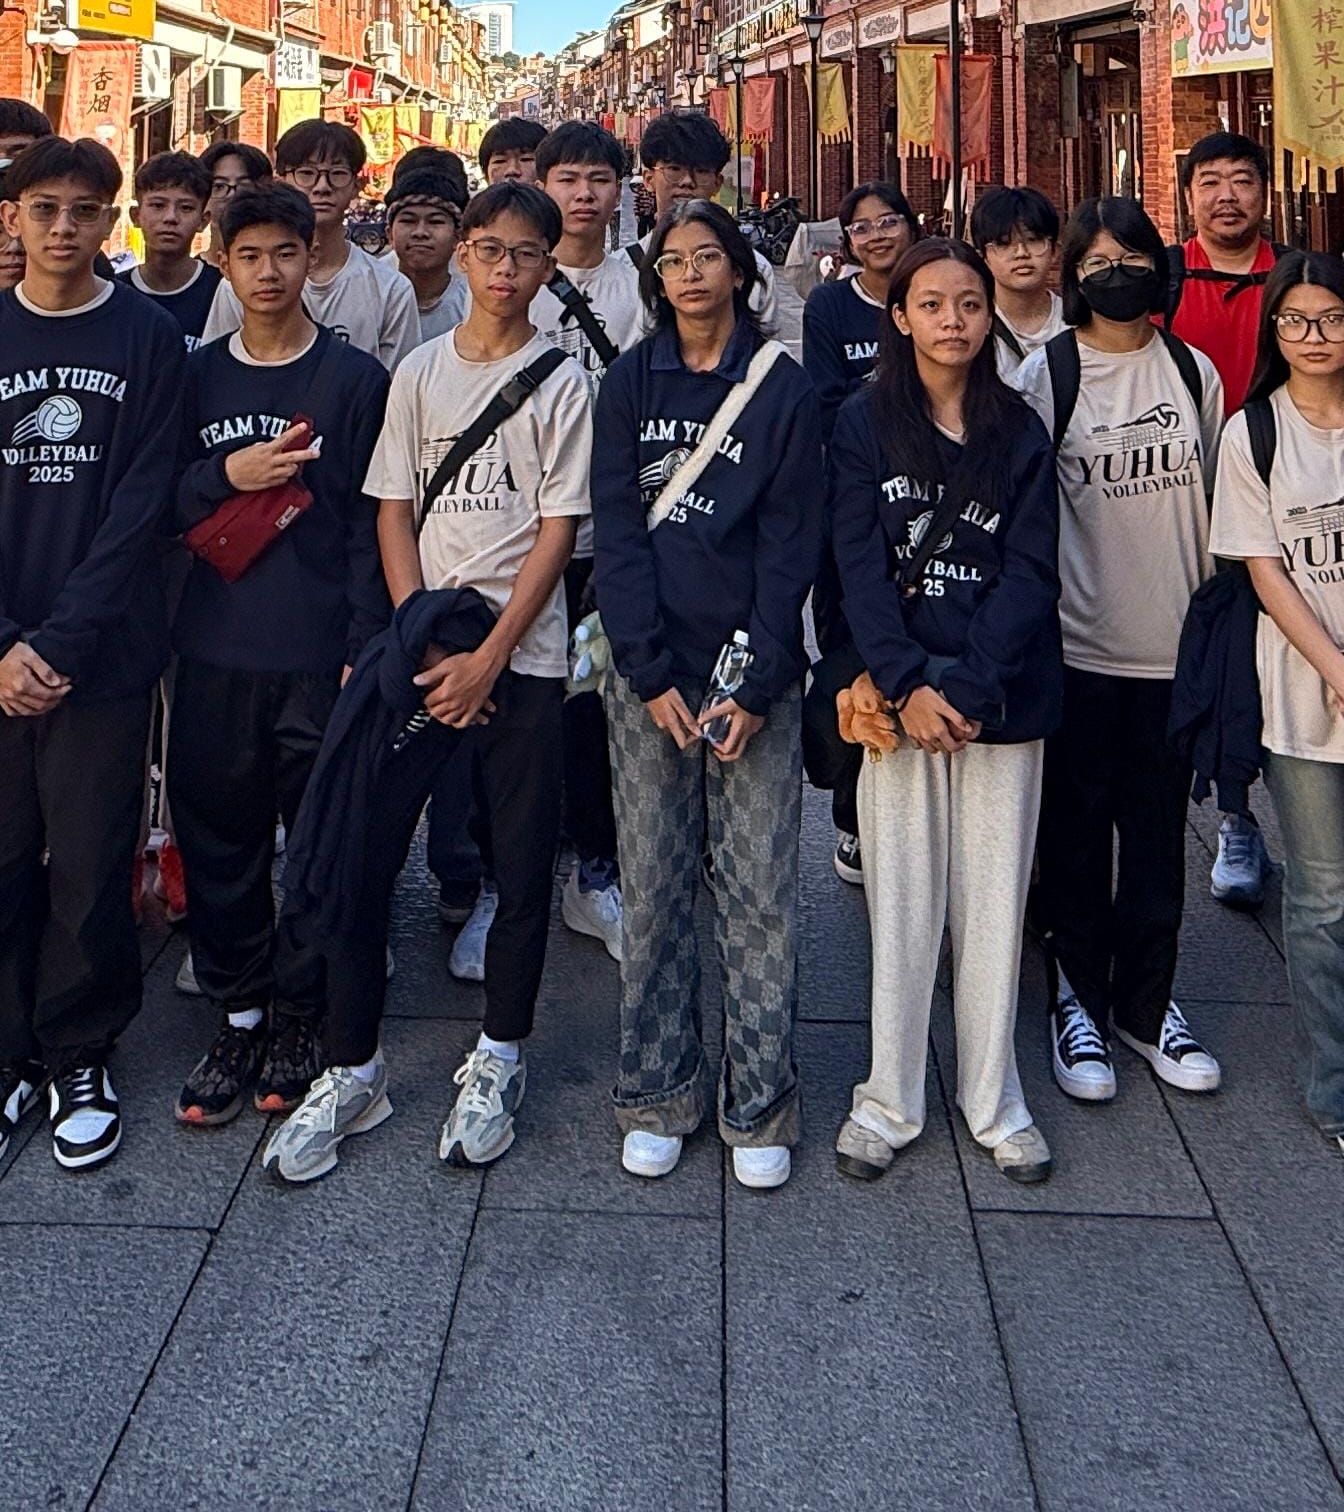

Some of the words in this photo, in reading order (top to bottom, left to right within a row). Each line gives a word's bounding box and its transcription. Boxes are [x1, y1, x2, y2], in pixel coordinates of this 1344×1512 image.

[87, 67, 114, 114] 香烟
[844, 341, 880, 361] EAM
[55, 366, 129, 402] YUHUA
[199, 415, 254, 449] TEAM
[259, 414, 324, 453] YUA
[640, 419, 677, 442] EAM
[1, 443, 104, 467] VOLLEYBALL
[1078, 439, 1202, 486] YUHUA
[28, 466, 75, 483] 2025
[1102, 472, 1199, 500] VOLLEYBALL
[429, 498, 504, 515] LLEYBALL
